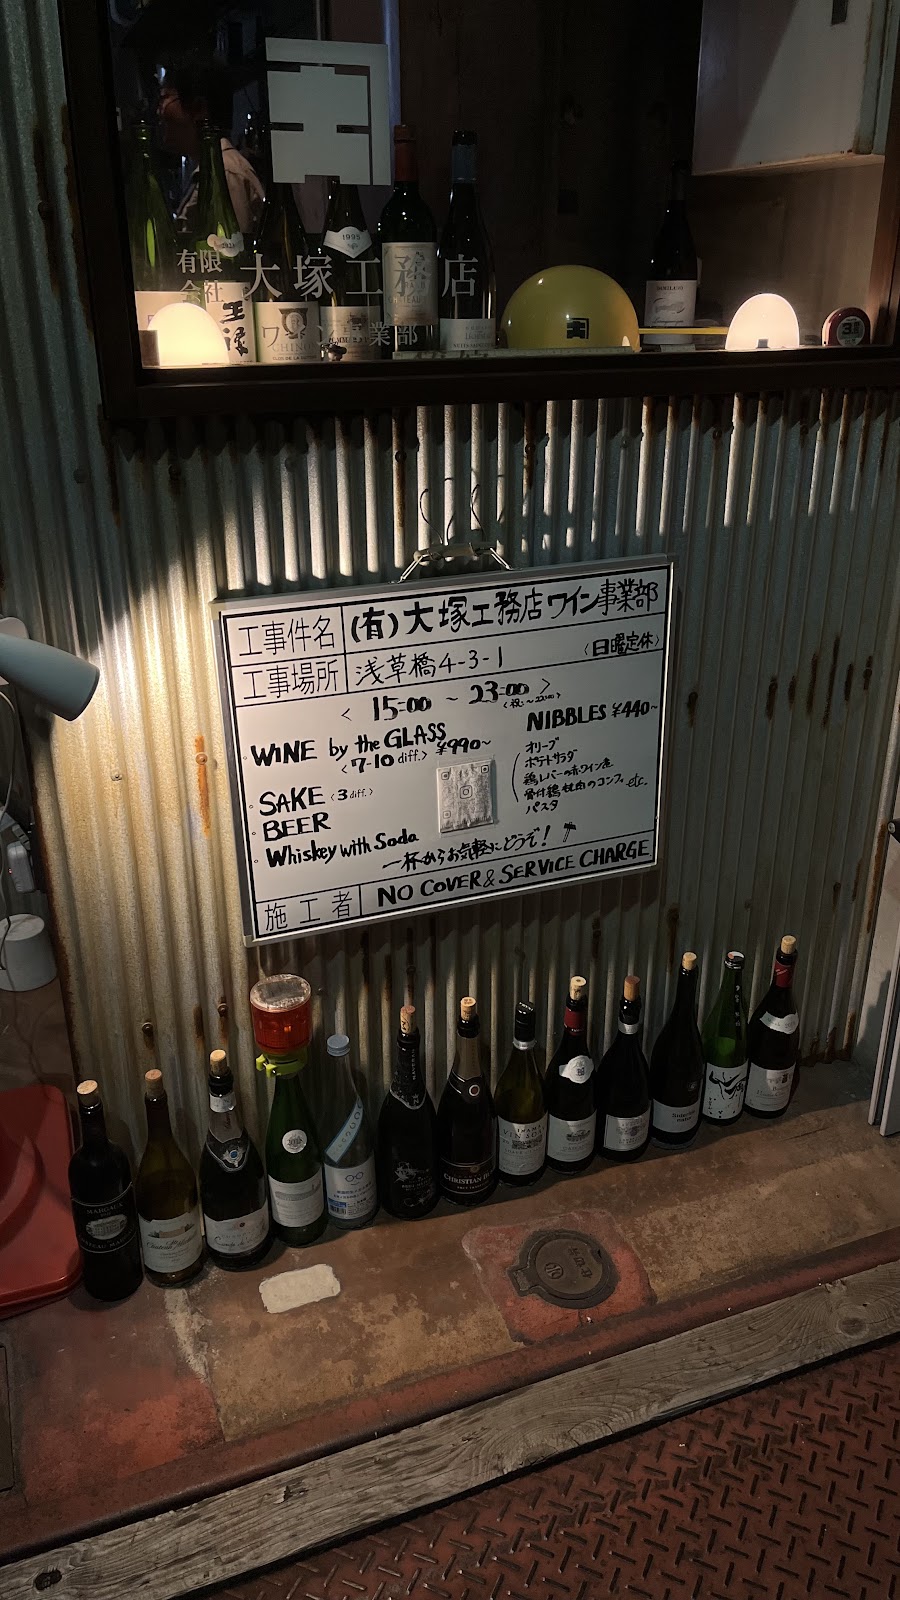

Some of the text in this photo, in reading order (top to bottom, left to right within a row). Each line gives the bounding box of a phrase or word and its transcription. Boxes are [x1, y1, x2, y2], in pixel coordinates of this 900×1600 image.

[176, 249, 223, 273] 有限
[240, 253, 479, 299] 大塚工務店
[238, 615, 334, 656] 工事件名
[243, 659, 338, 700] 工事場所
[373, 696, 432, 721] 15:00
[469, 681, 530, 705] 23:00
[527, 704, 606, 731] NIBBLES
[250, 740, 317, 767] WINE
[329, 738, 349, 761] by
[354, 734, 380, 754] the
[384, 723, 447, 749] GLASS
[525, 749, 577, 768] ポテトサラダ
[526, 737, 559, 753] オリーブ
[260, 786, 326, 816] SAKE
[526, 799, 559, 814] パスタ
[263, 812, 331, 841] BEER
[266, 828, 419, 868] Whiskey with Soda
[378, 884, 413, 907] NO
[420, 870, 481, 899] COVER
[483, 869, 495, 888] &
[499, 855, 575, 885] SERVICE
[265, 890, 352, 931] 施工者
